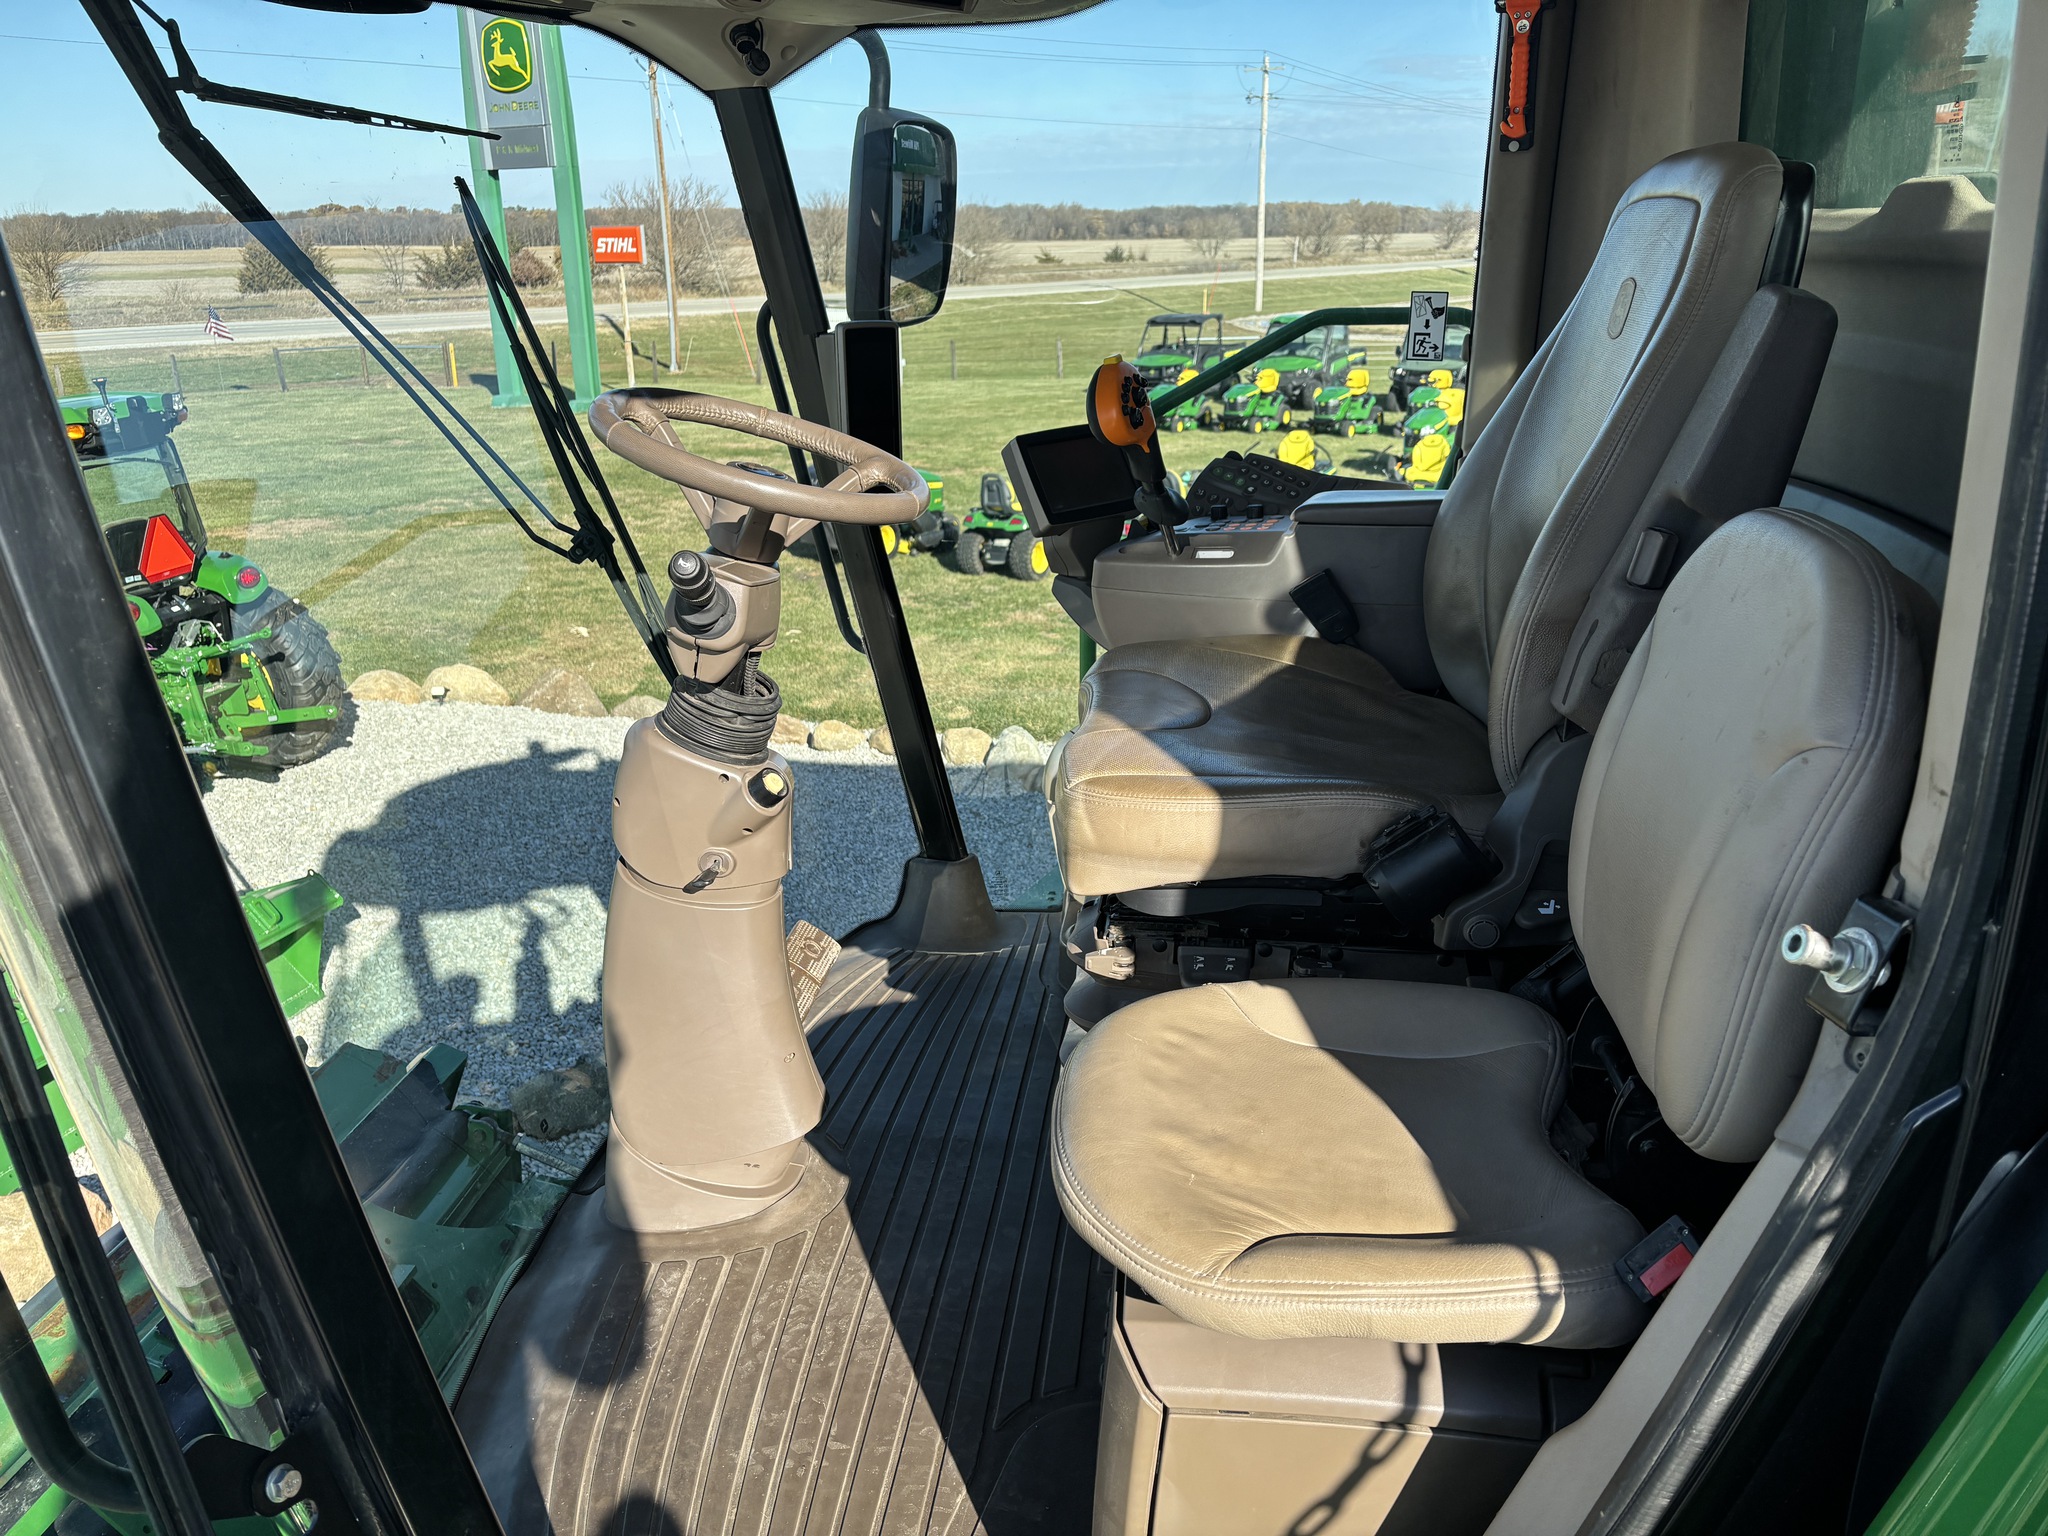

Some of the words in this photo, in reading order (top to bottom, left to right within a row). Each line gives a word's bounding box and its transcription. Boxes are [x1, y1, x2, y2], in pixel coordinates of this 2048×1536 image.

[490, 102, 510, 113] JOHN
[511, 100, 539, 111] DEERE
[595, 236, 637, 253] STIHL
